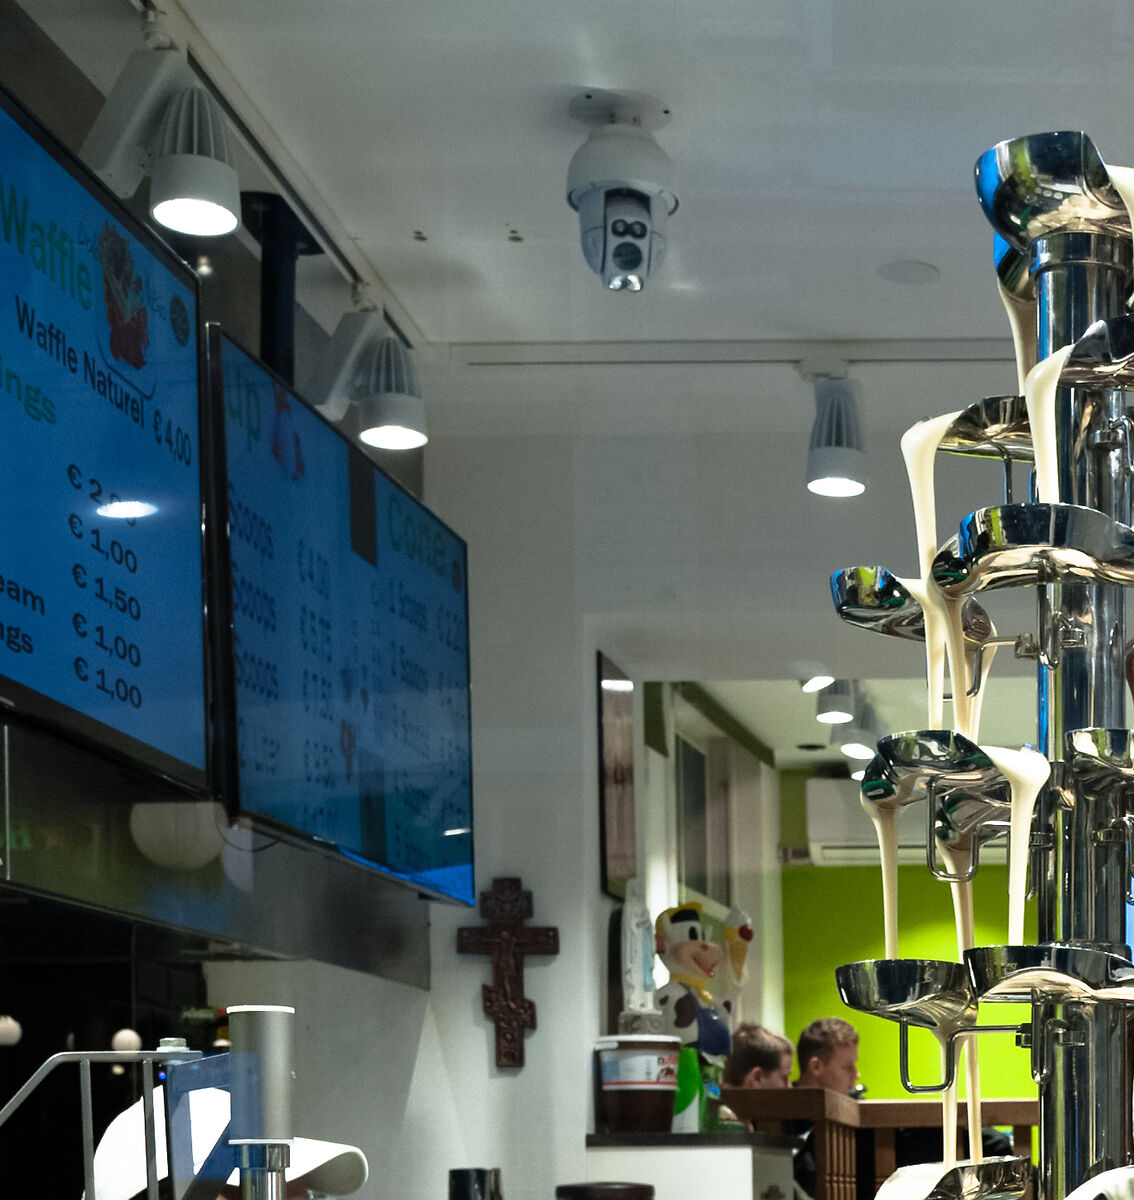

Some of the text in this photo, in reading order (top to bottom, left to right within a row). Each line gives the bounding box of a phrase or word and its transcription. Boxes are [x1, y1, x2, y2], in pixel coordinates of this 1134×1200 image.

[0, 172, 92, 311] Waffle
[15, 295, 78, 374] Waffle
[83, 350, 145, 428] Naturel
[91, 529, 138, 574] 1,00
[95, 577, 141, 621] 1,50
[95, 626, 142, 668] 1,00
[96, 668, 142, 709] 1,00
